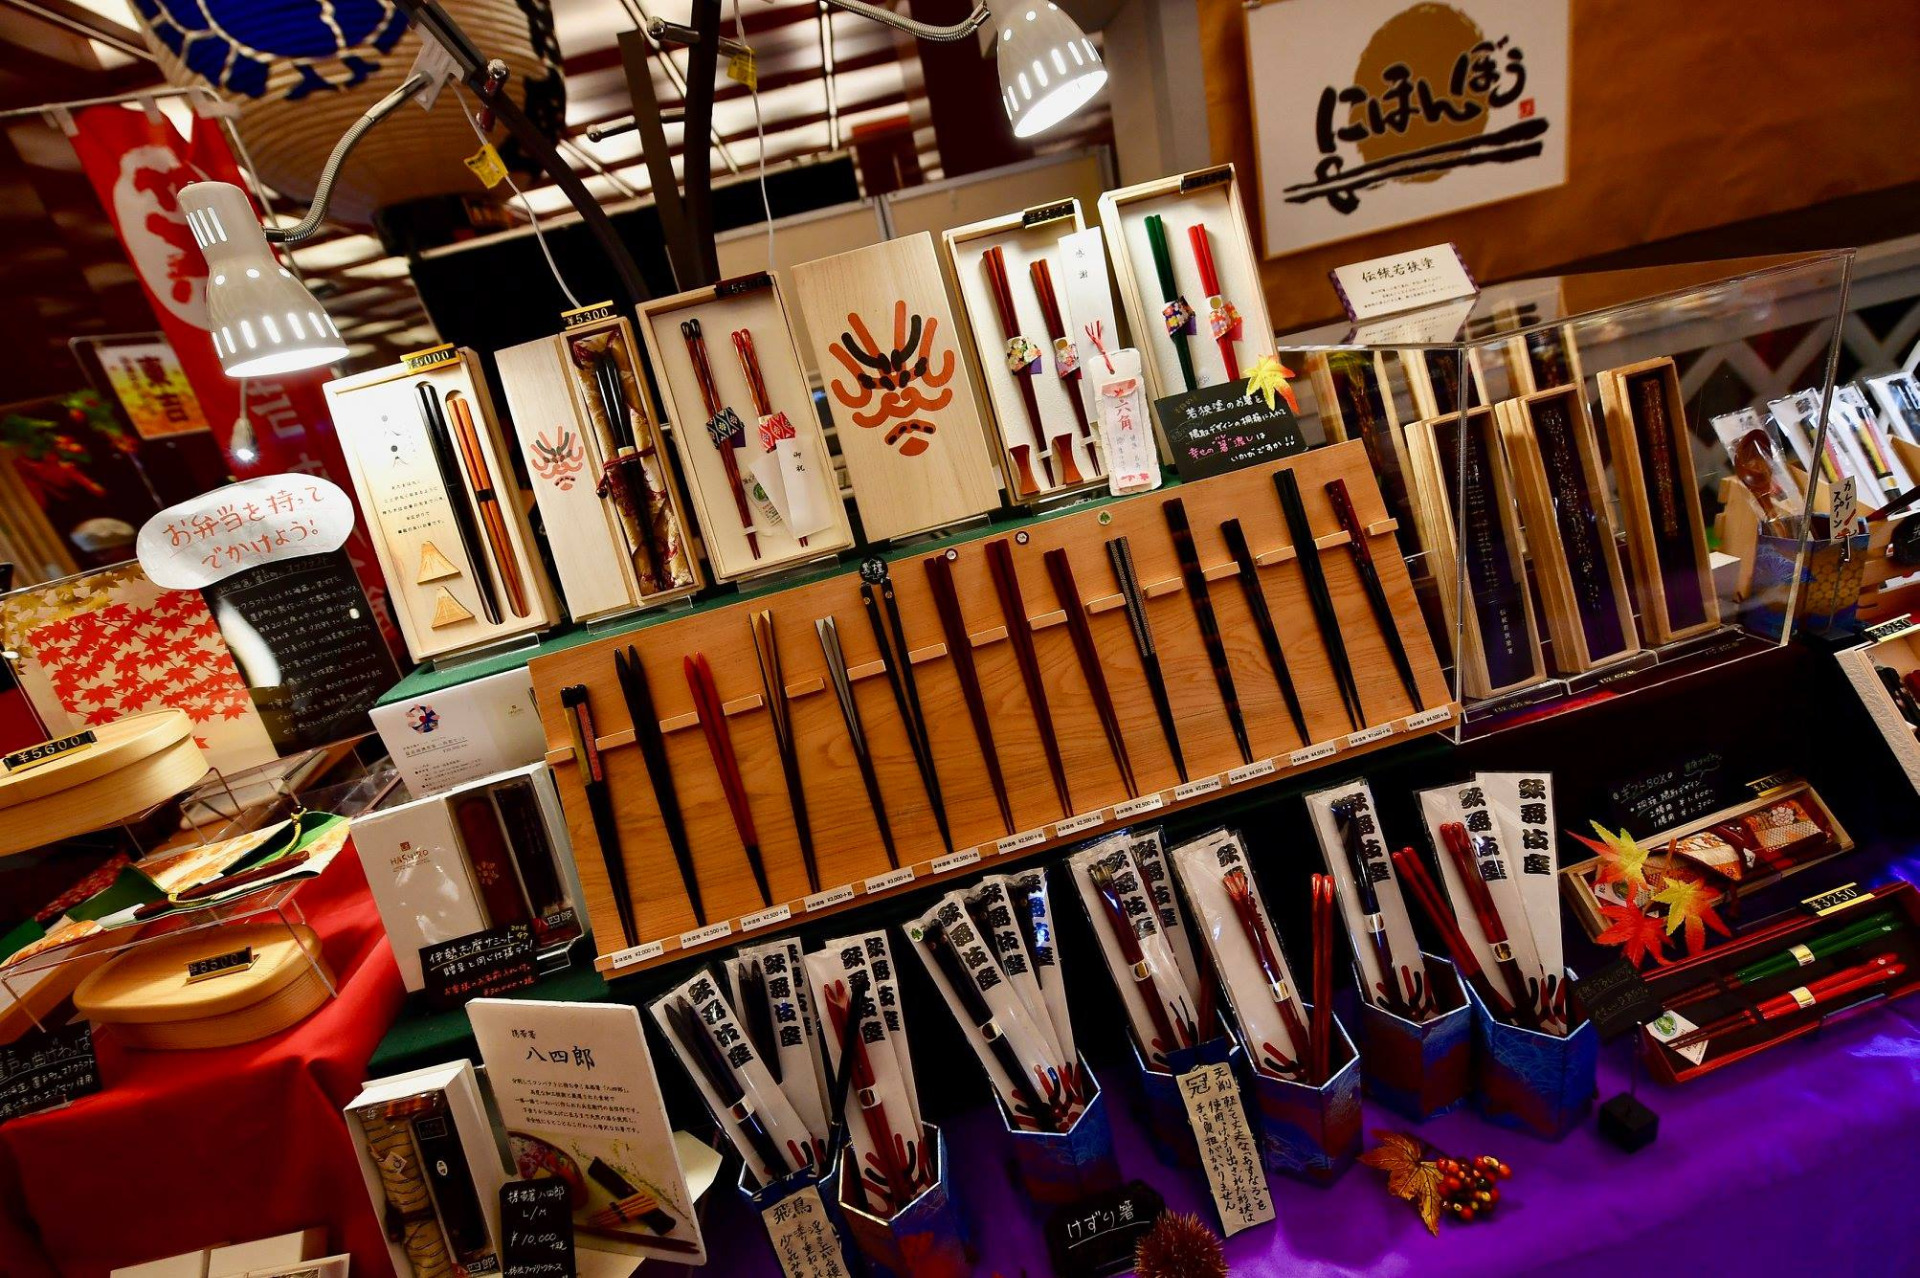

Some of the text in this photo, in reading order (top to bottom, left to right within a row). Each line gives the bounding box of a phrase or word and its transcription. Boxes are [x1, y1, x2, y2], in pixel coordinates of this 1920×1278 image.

[1360, 255, 1435, 283] 伝統若狭塗
[566, 307, 609, 326] ¥5300
[406, 350, 450, 370] ¥5000
[1114, 399, 1134, 432] 六角
[1832, 490, 1844, 529] スプーン
[1842, 481, 1853, 511] カレー
[162, 486, 325, 548] お弁当を持って
[201, 518, 320, 570] でかけよう!
[18, 734, 82, 763] ¥5600
[1458, 787, 1508, 882] 歌舞伎座
[1518, 778, 1551, 876] 歌舞伎座
[1810, 887, 1858, 911] ¥3250
[937, 901, 1002, 992] 歌舞伎座
[762, 953, 803, 1048] 歌舞伎座
[688, 978, 754, 1070] 歌舞伎座
[526, 1045, 596, 1072] 八四郎
[1184, 1071, 1212, 1099] 冠
[1196, 1103, 1236, 1212] 手に負担がかかりません
[770, 1194, 813, 1224] 飛鳥
[1064, 1198, 1137, 1240] けずり箸
